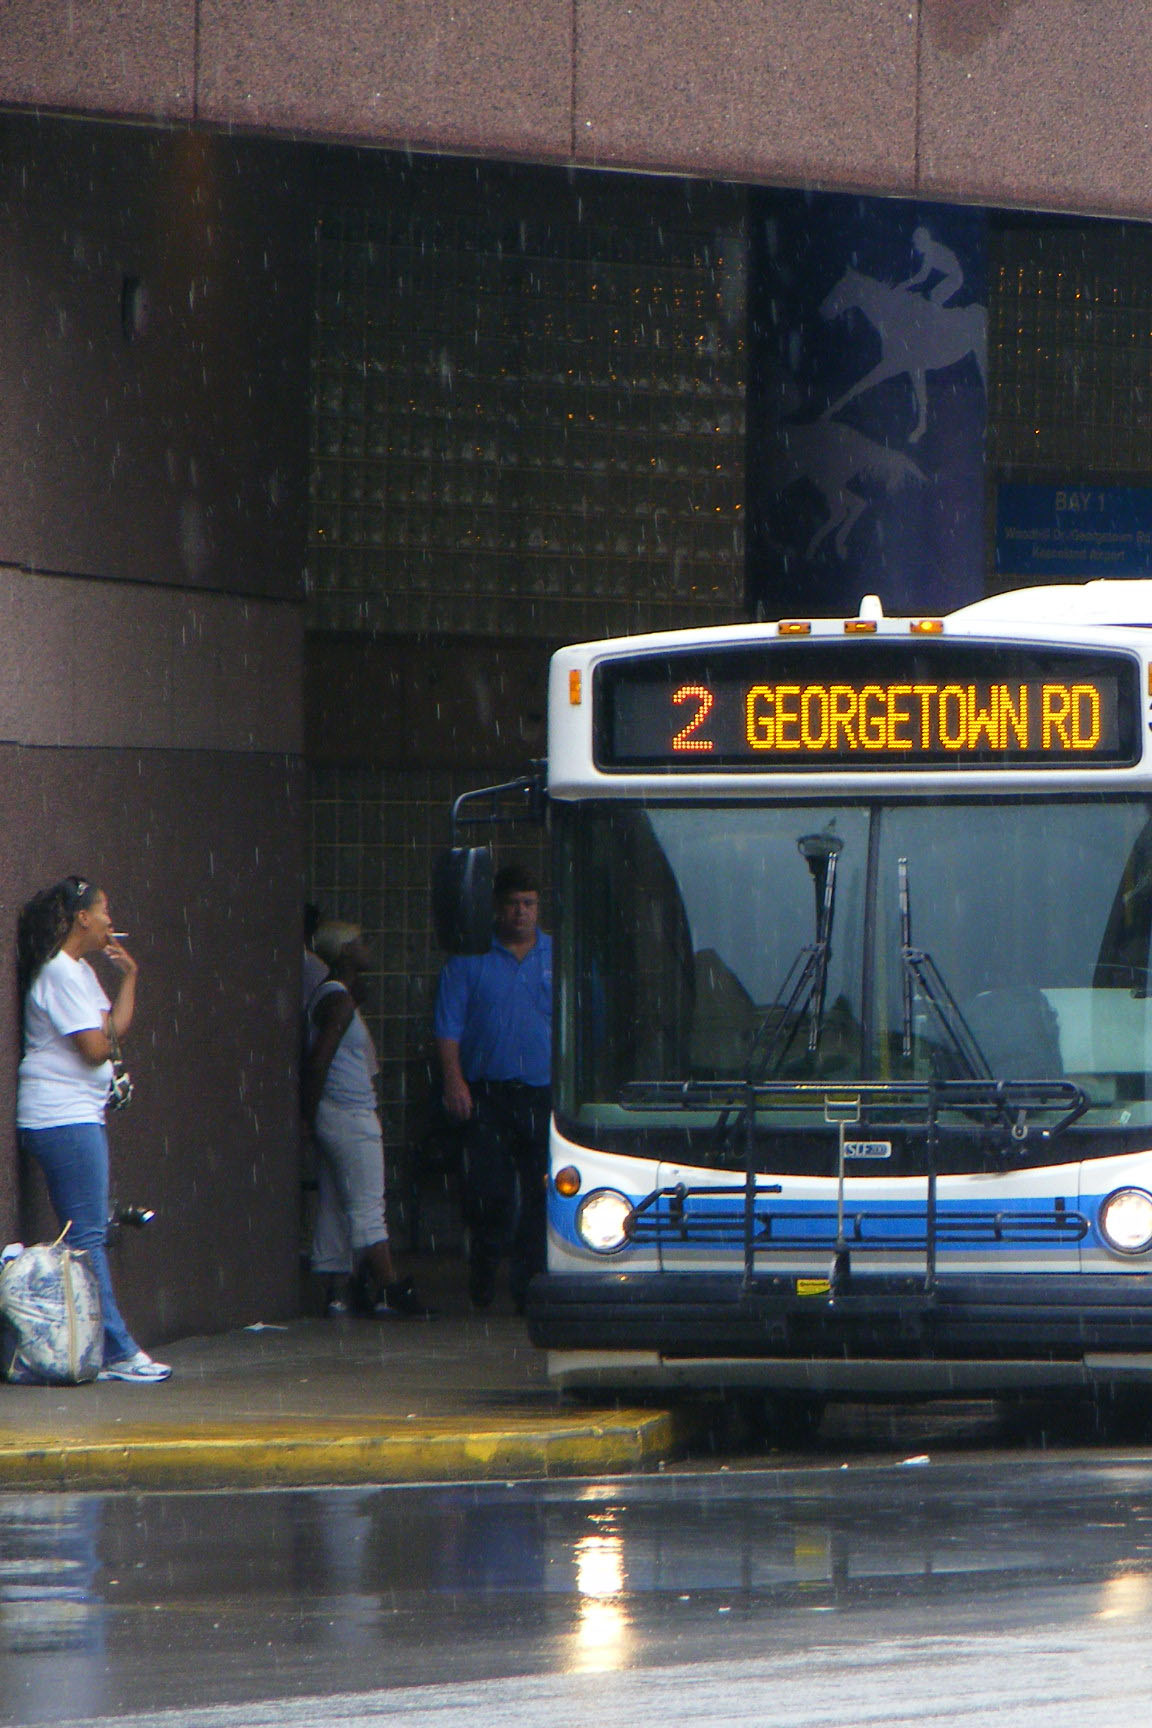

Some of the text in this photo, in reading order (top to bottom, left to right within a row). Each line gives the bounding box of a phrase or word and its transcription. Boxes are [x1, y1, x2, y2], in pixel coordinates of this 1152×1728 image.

[1055, 490, 1105, 513] BAY 1
[672, 684, 1100, 751] 2 GEORGETOWN RD
